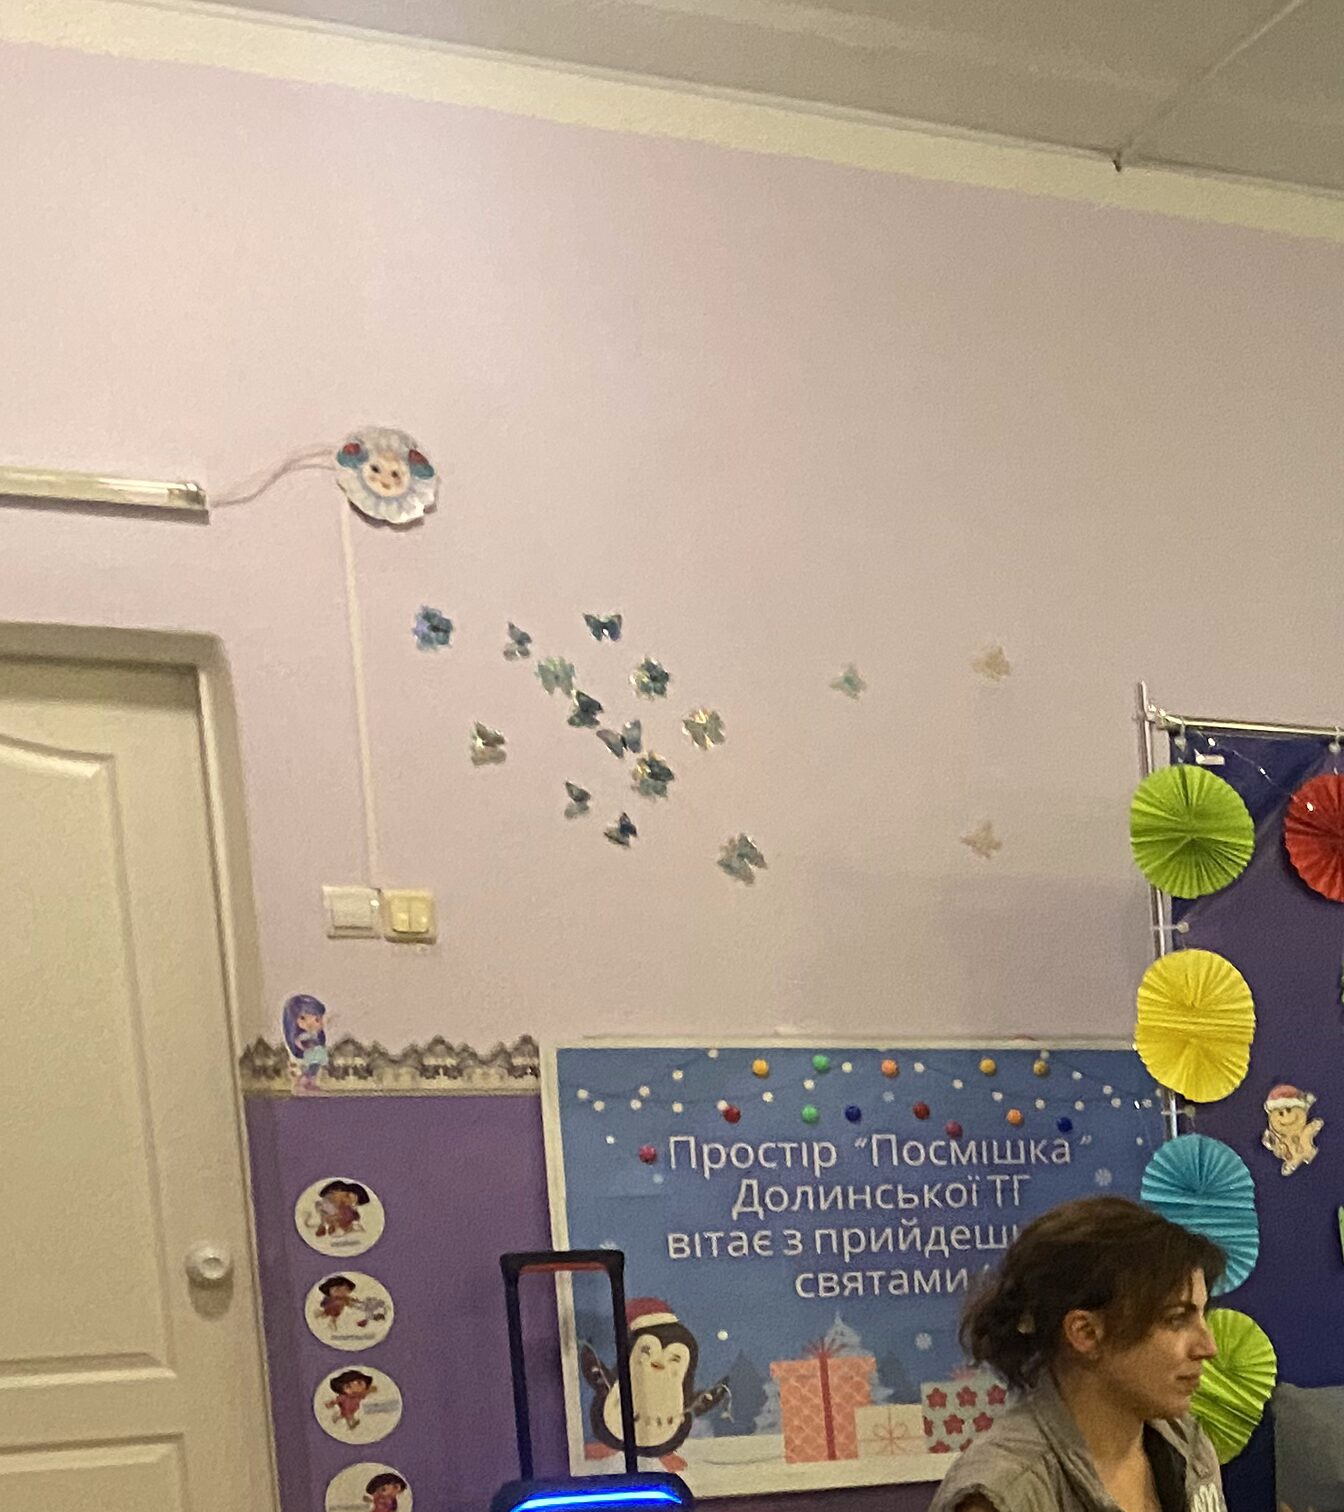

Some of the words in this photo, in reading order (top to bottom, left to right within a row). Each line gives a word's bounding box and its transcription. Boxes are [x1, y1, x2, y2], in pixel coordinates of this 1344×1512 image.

[669, 1135, 838, 1179] Простір
[731, 1175, 979, 1221] Долинської
[667, 1230, 775, 1259] вітає
[783, 1229, 803, 1257] з
[795, 1268, 969, 1299] святами
